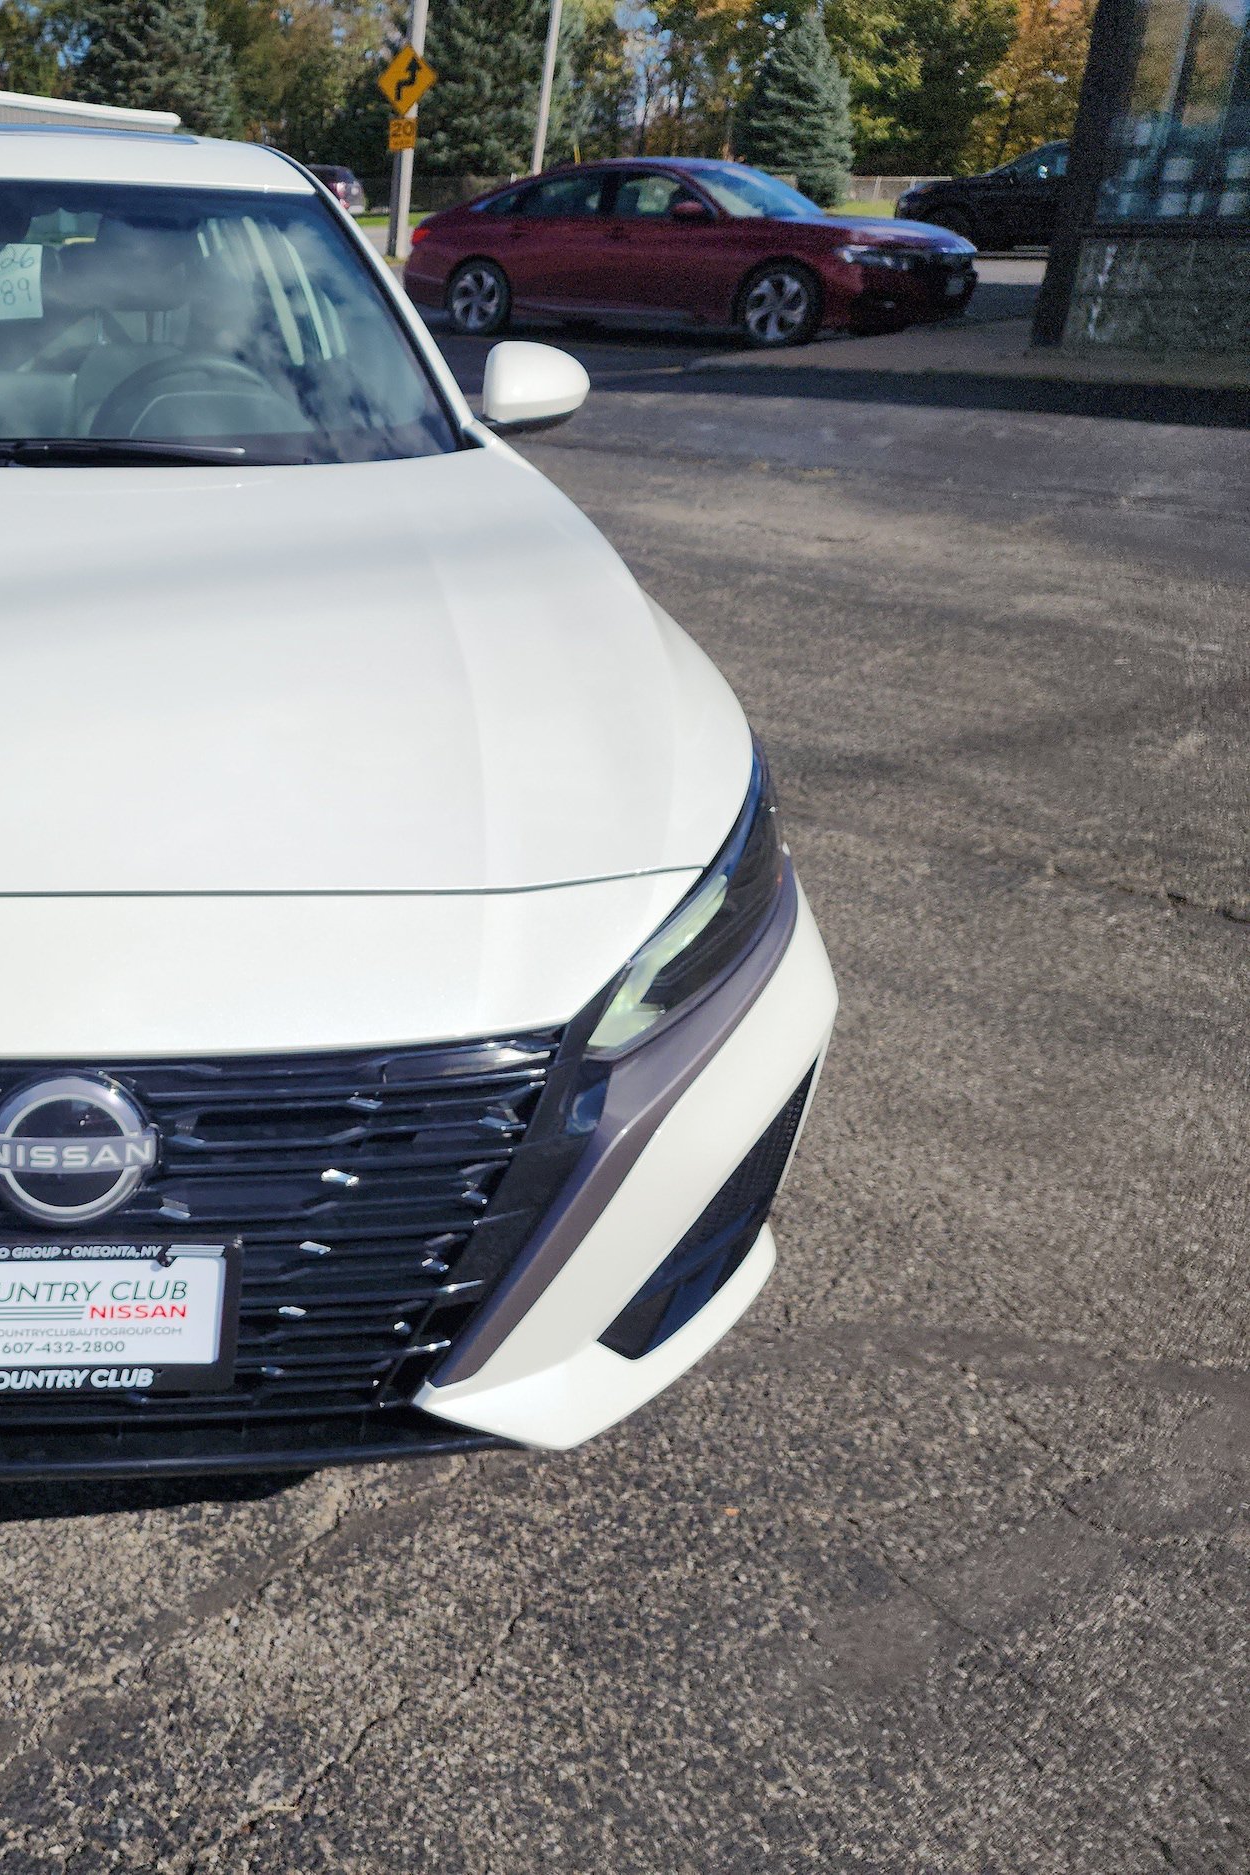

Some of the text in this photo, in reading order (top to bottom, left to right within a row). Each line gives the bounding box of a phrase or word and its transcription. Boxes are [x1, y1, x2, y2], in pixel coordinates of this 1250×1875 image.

[11, 1246, 62, 1260] GROUP
[111, 1280, 189, 1302] CLUB
[90, 1304, 187, 1320] NISSAN
[2, 1341, 126, 1355] 607-432-2800
[90, 1367, 154, 1388] CLUB
